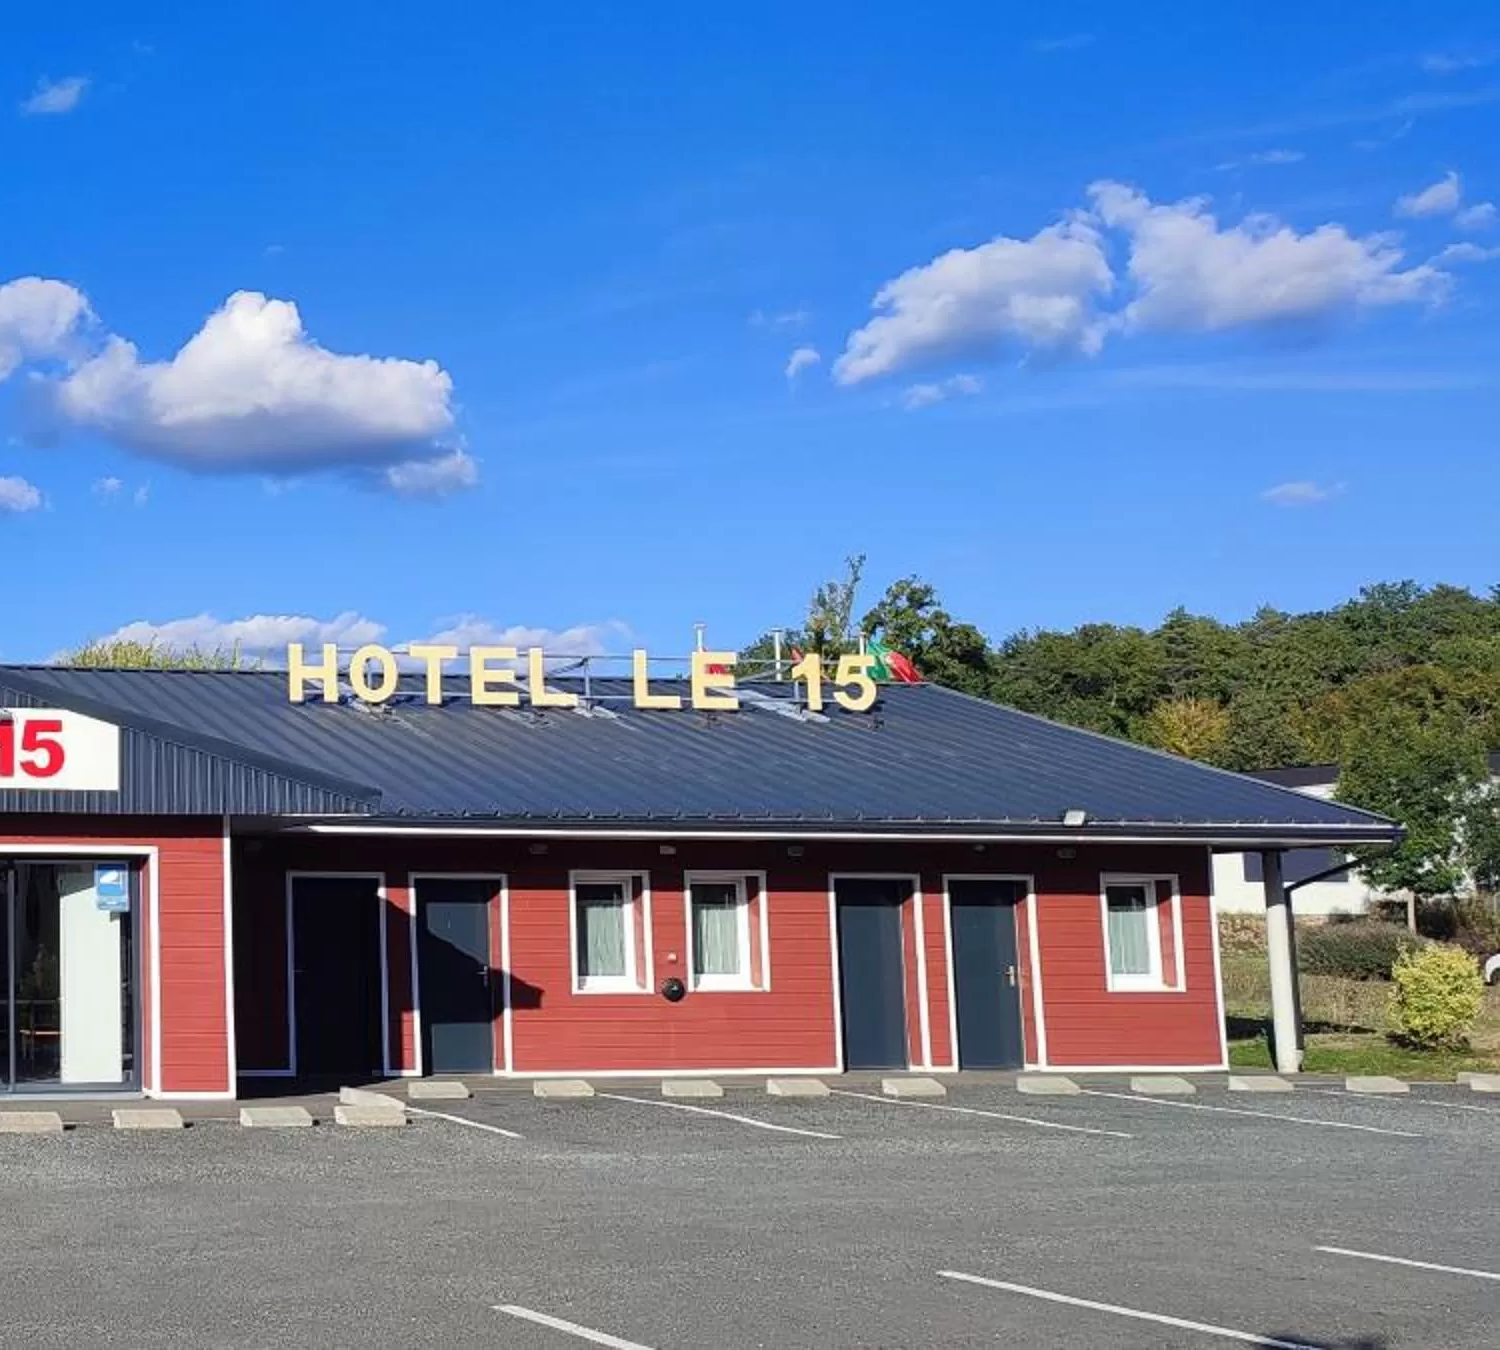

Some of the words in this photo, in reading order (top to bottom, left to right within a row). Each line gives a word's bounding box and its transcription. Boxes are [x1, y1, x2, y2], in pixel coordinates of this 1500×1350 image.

[288, 643, 578, 706] HOTEL
[633, 649, 739, 709] LE
[791, 653, 877, 711] 15
